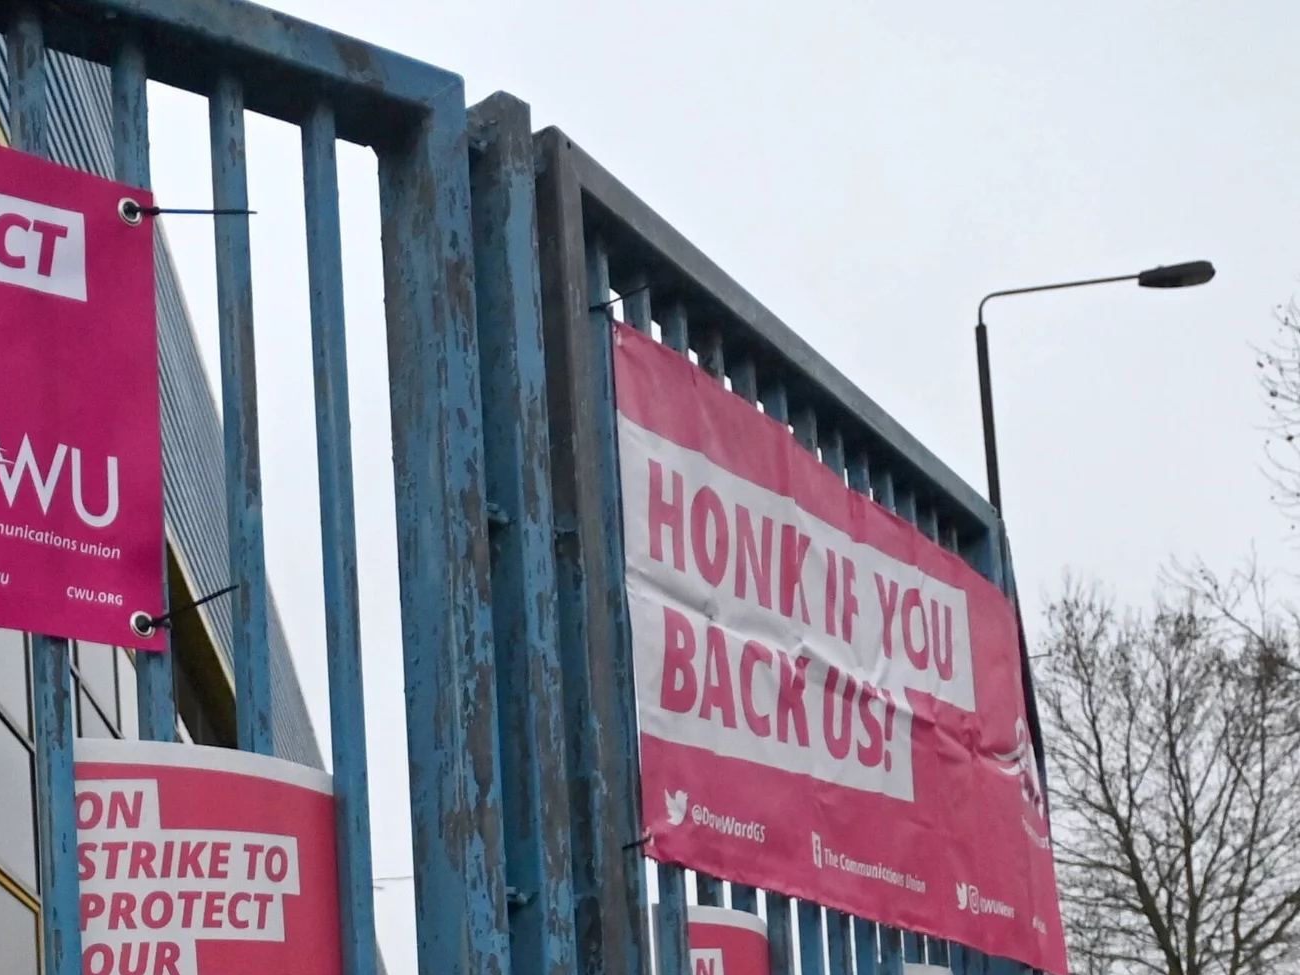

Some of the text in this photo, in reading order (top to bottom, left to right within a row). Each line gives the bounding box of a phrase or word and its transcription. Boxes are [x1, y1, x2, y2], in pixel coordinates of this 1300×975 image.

[80, 541, 121, 559] union
[648, 458, 953, 681] HONK IF YOU
[66, 586, 123, 606] CWU.ORG
[660, 606, 811, 747] BACK
[823, 667, 896, 772] US!
[75, 791, 143, 830] ON
[77, 841, 288, 883] STRIKE TO
[80, 891, 273, 931] PROTECT
